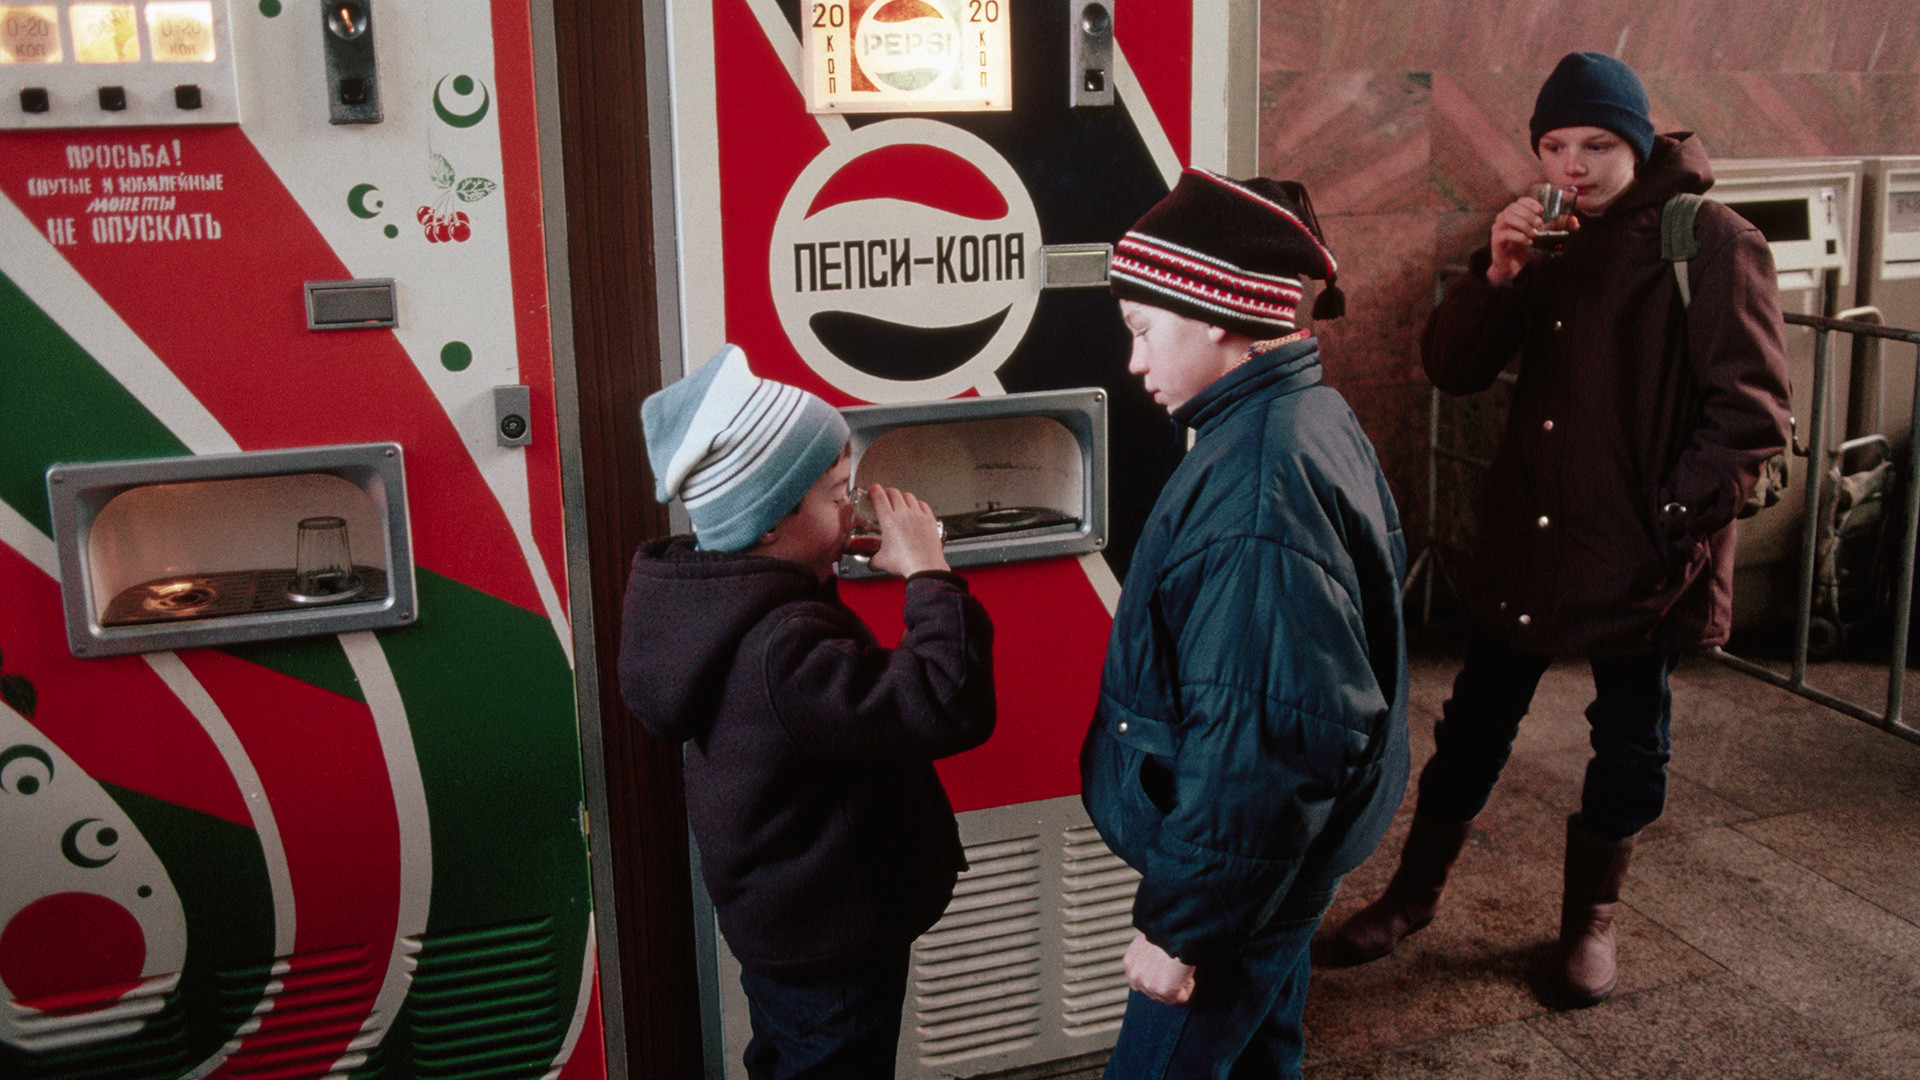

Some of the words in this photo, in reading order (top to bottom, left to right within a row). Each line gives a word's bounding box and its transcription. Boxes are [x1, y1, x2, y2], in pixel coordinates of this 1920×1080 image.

[813, 2, 844, 28] 20
[968, 0, 999, 22] 20
[6, 17, 49, 37] 0-20
[863, 32, 952, 57] PEPSI
[66, 139, 182, 169] ПРОСЬБА!
[102, 176, 114, 194] И
[118, 172, 224, 194] ЮБИЛЕЙНЫЕ
[46, 217, 78, 245] НЕ
[92, 213, 222, 244] ОПУСКАТЬ
[793, 232, 1025, 293] ПЕПСИ-КОЛА
